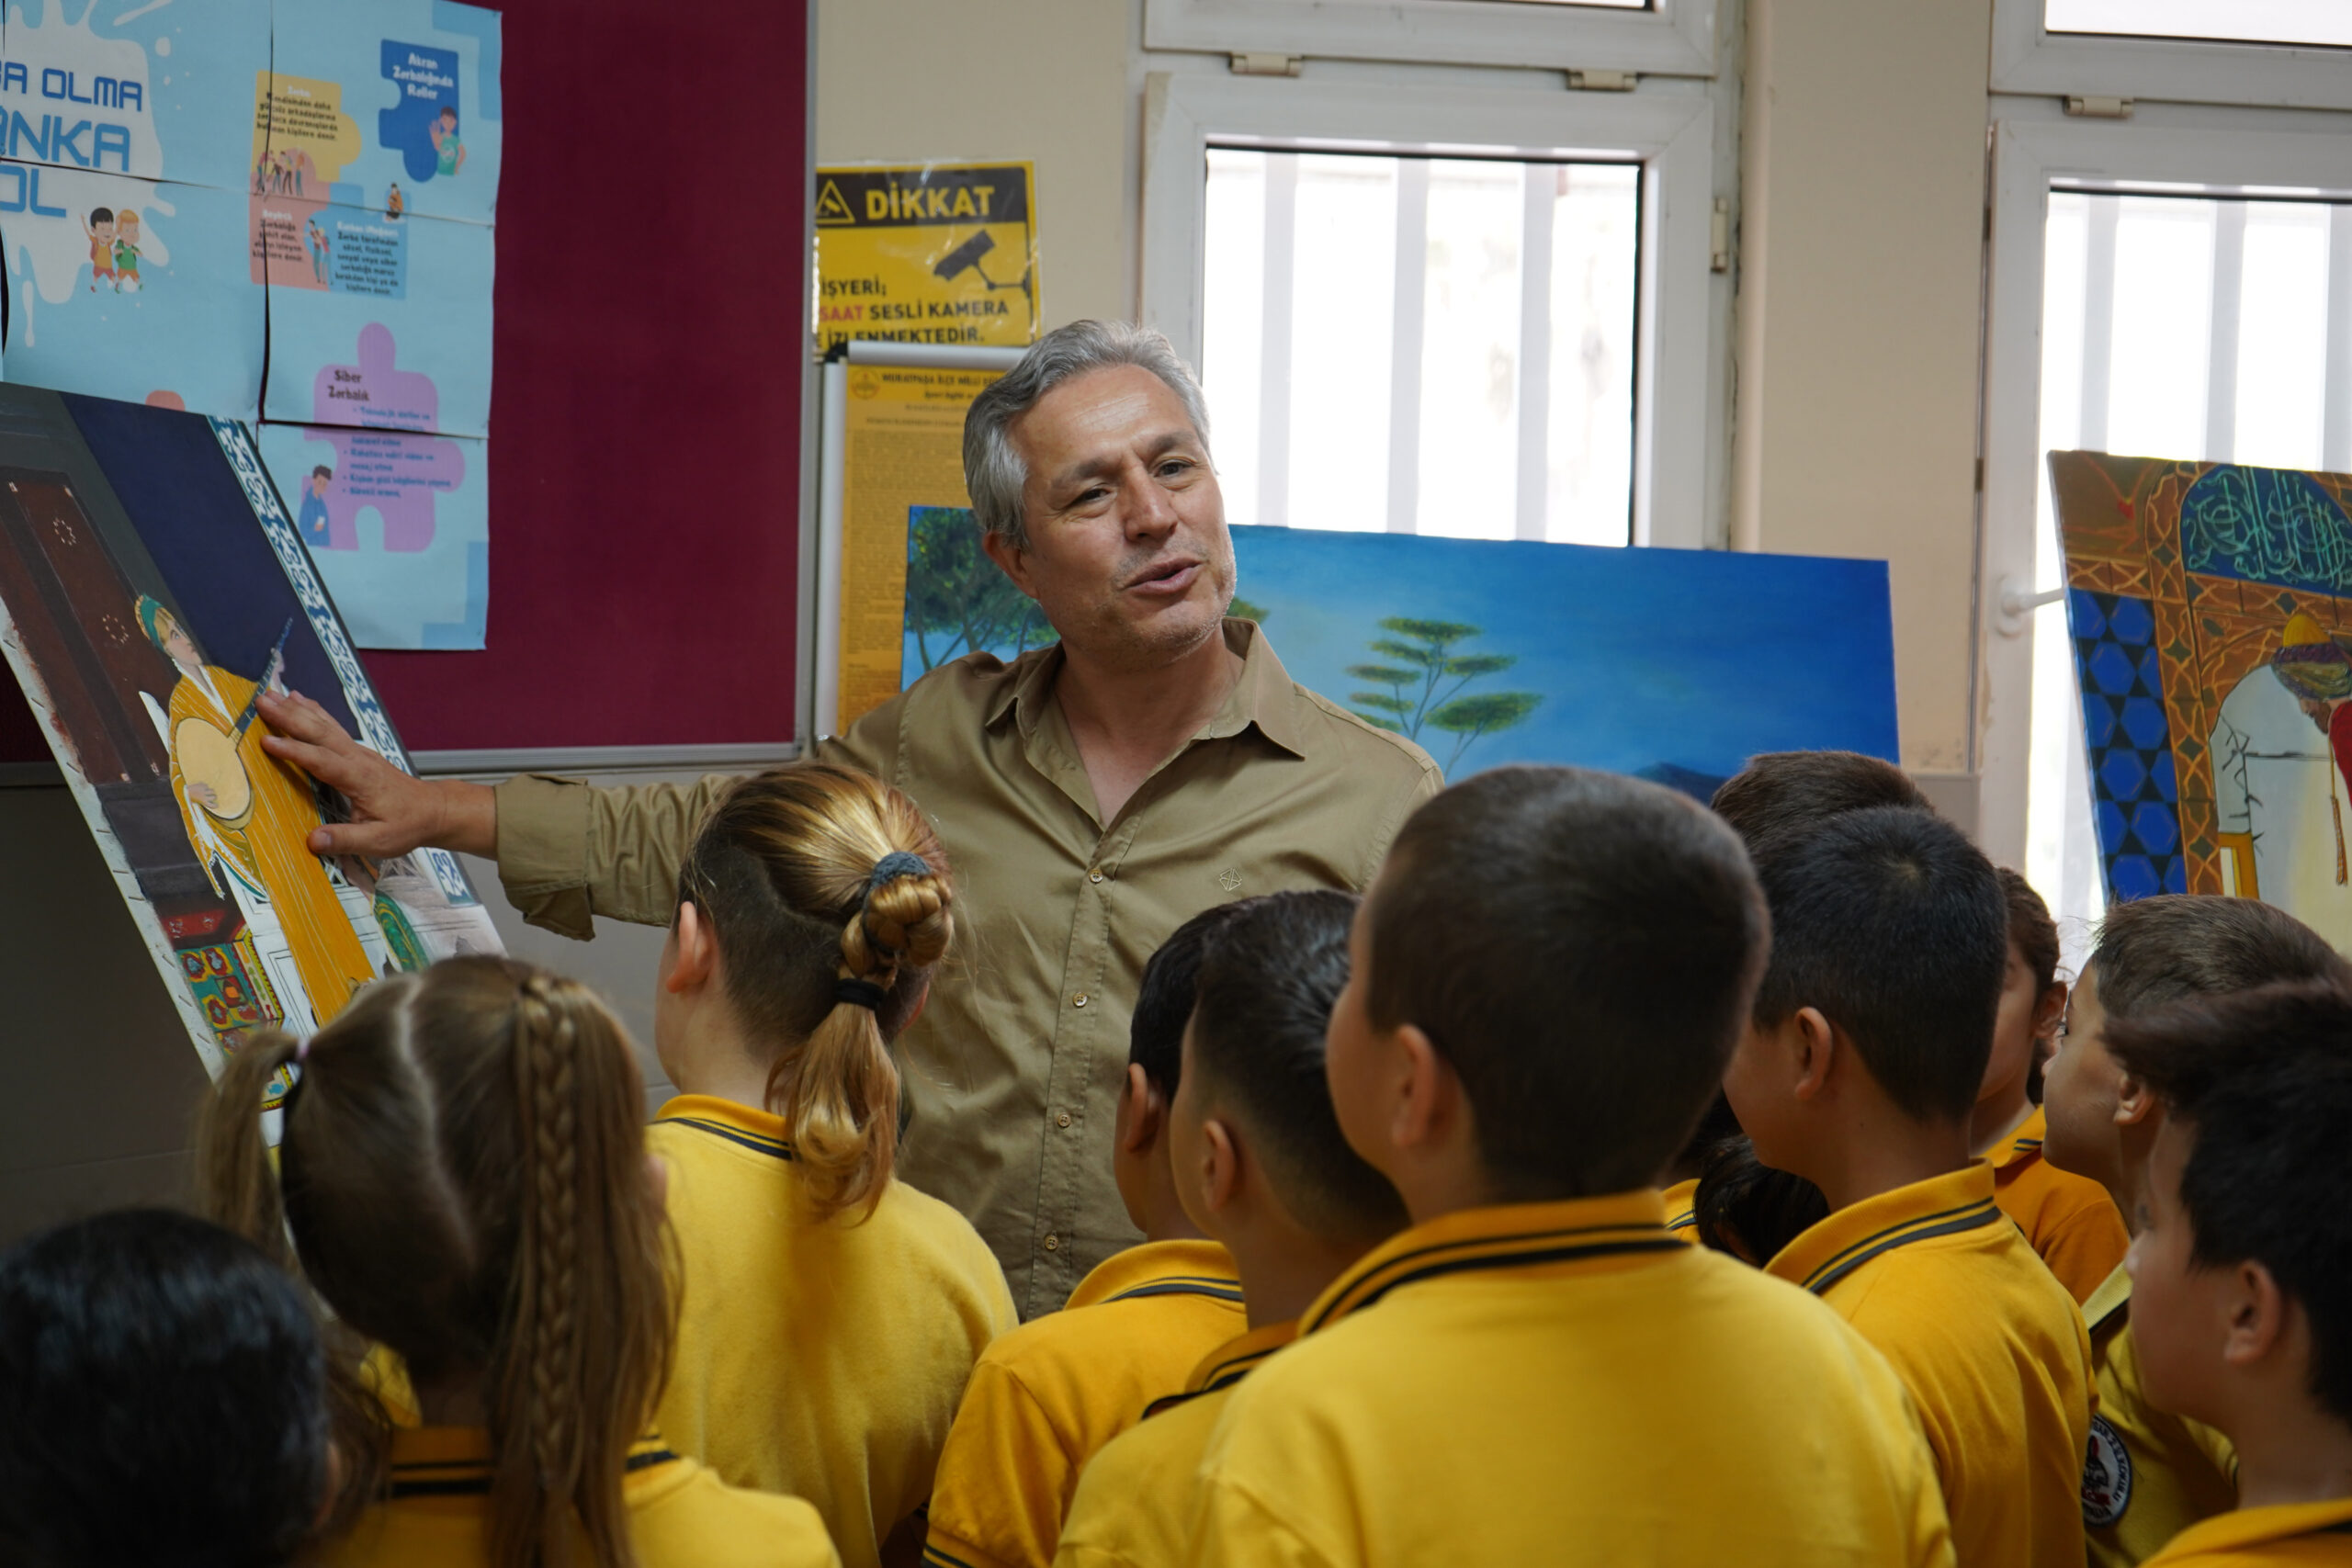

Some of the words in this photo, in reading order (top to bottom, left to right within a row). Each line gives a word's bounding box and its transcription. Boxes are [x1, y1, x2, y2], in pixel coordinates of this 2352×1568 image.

[408, 52, 438, 69] Akran
[0, 61, 28, 94] A
[42, 68, 142, 112] OLMA
[407, 83, 438, 99] Roller
[0, 106, 130, 173] NKA
[865, 182, 994, 221] DİKKAT
[820, 305, 864, 321] SAAT
[870, 299, 922, 320] SESLİ
[929, 300, 1009, 318] KAMERA
[334, 369, 361, 384] Siber
[327, 385, 369, 401] Zorbalık
